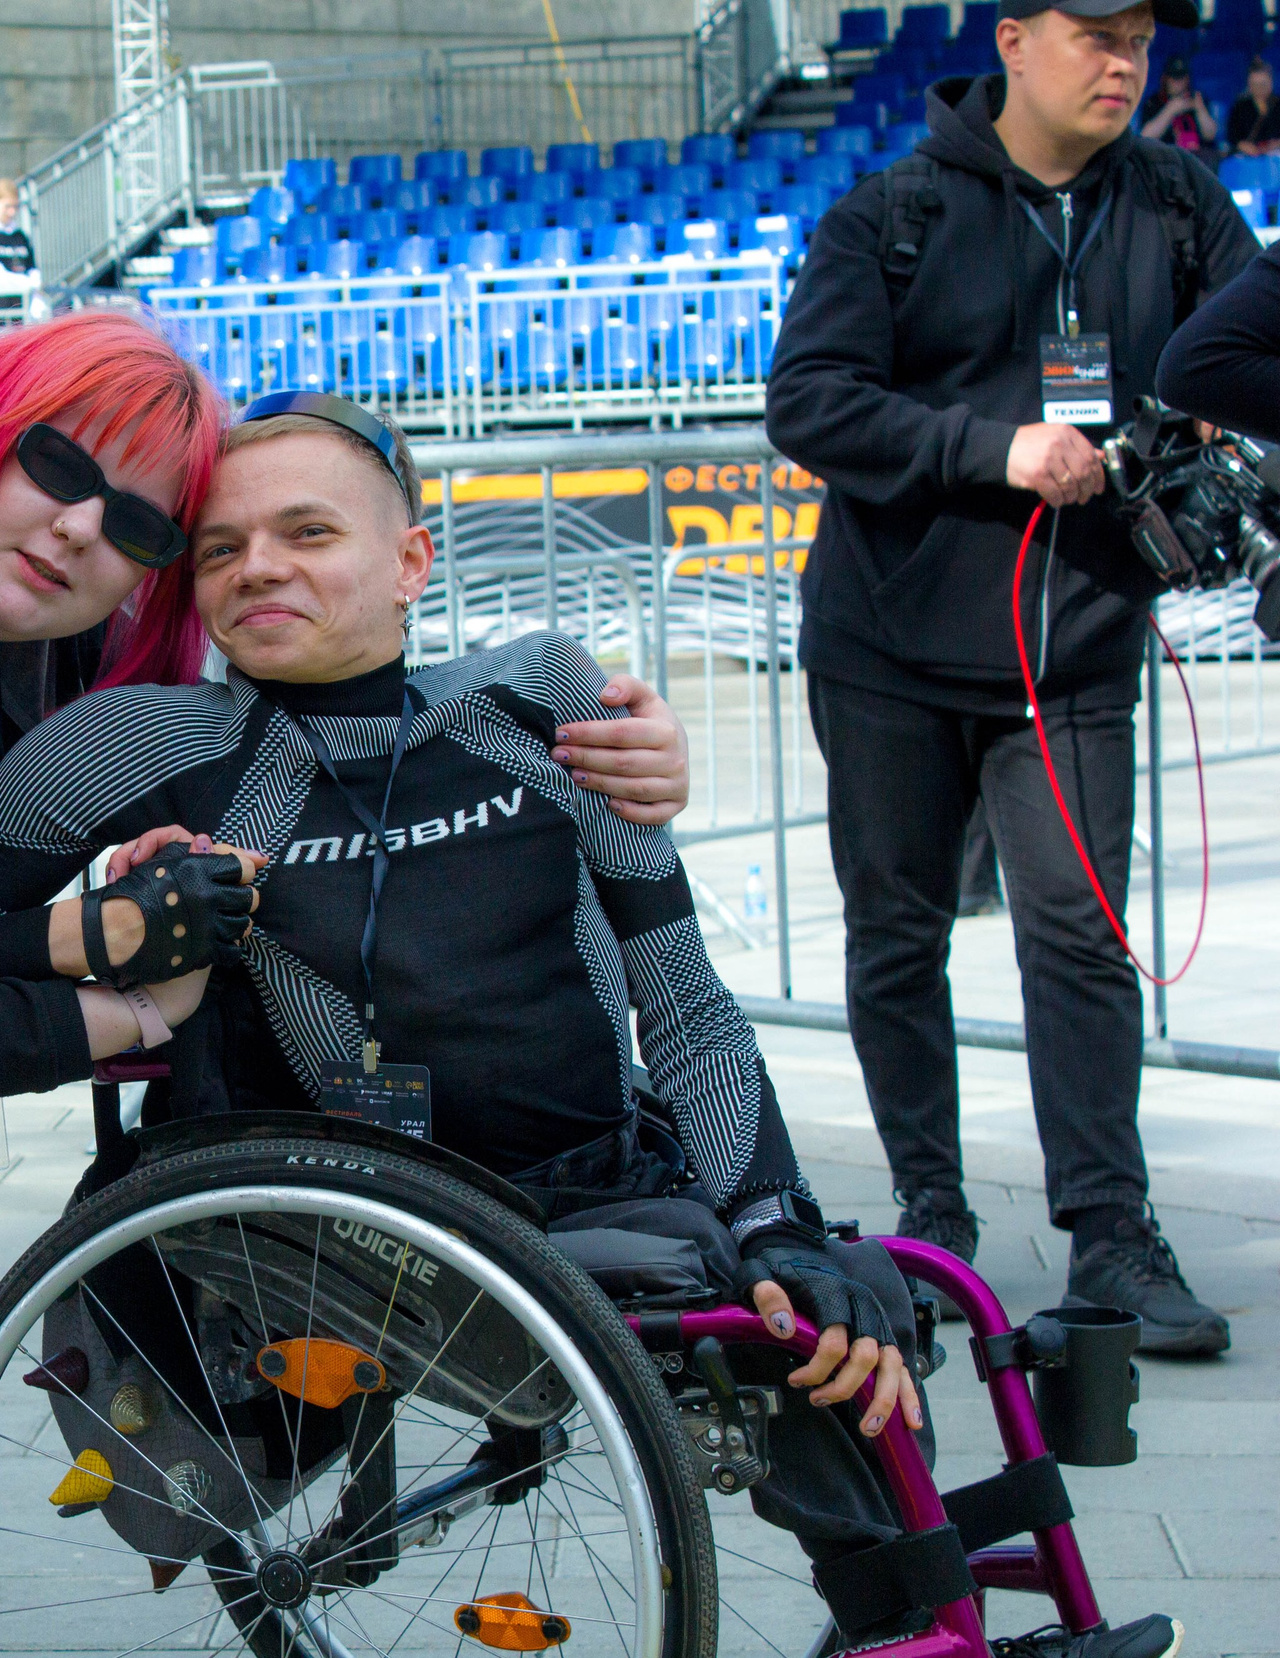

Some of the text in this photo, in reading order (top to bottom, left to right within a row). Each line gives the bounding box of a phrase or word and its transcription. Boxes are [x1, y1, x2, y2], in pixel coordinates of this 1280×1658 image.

[284, 786, 523, 864] MISBHV
[325, 1109, 362, 1118] ФЕСТИВАЛЬ
[400, 1119, 426, 1128] УРАЛ
[286, 1155, 375, 1175] KENDA
[333, 1217, 440, 1286] QUICKIE
